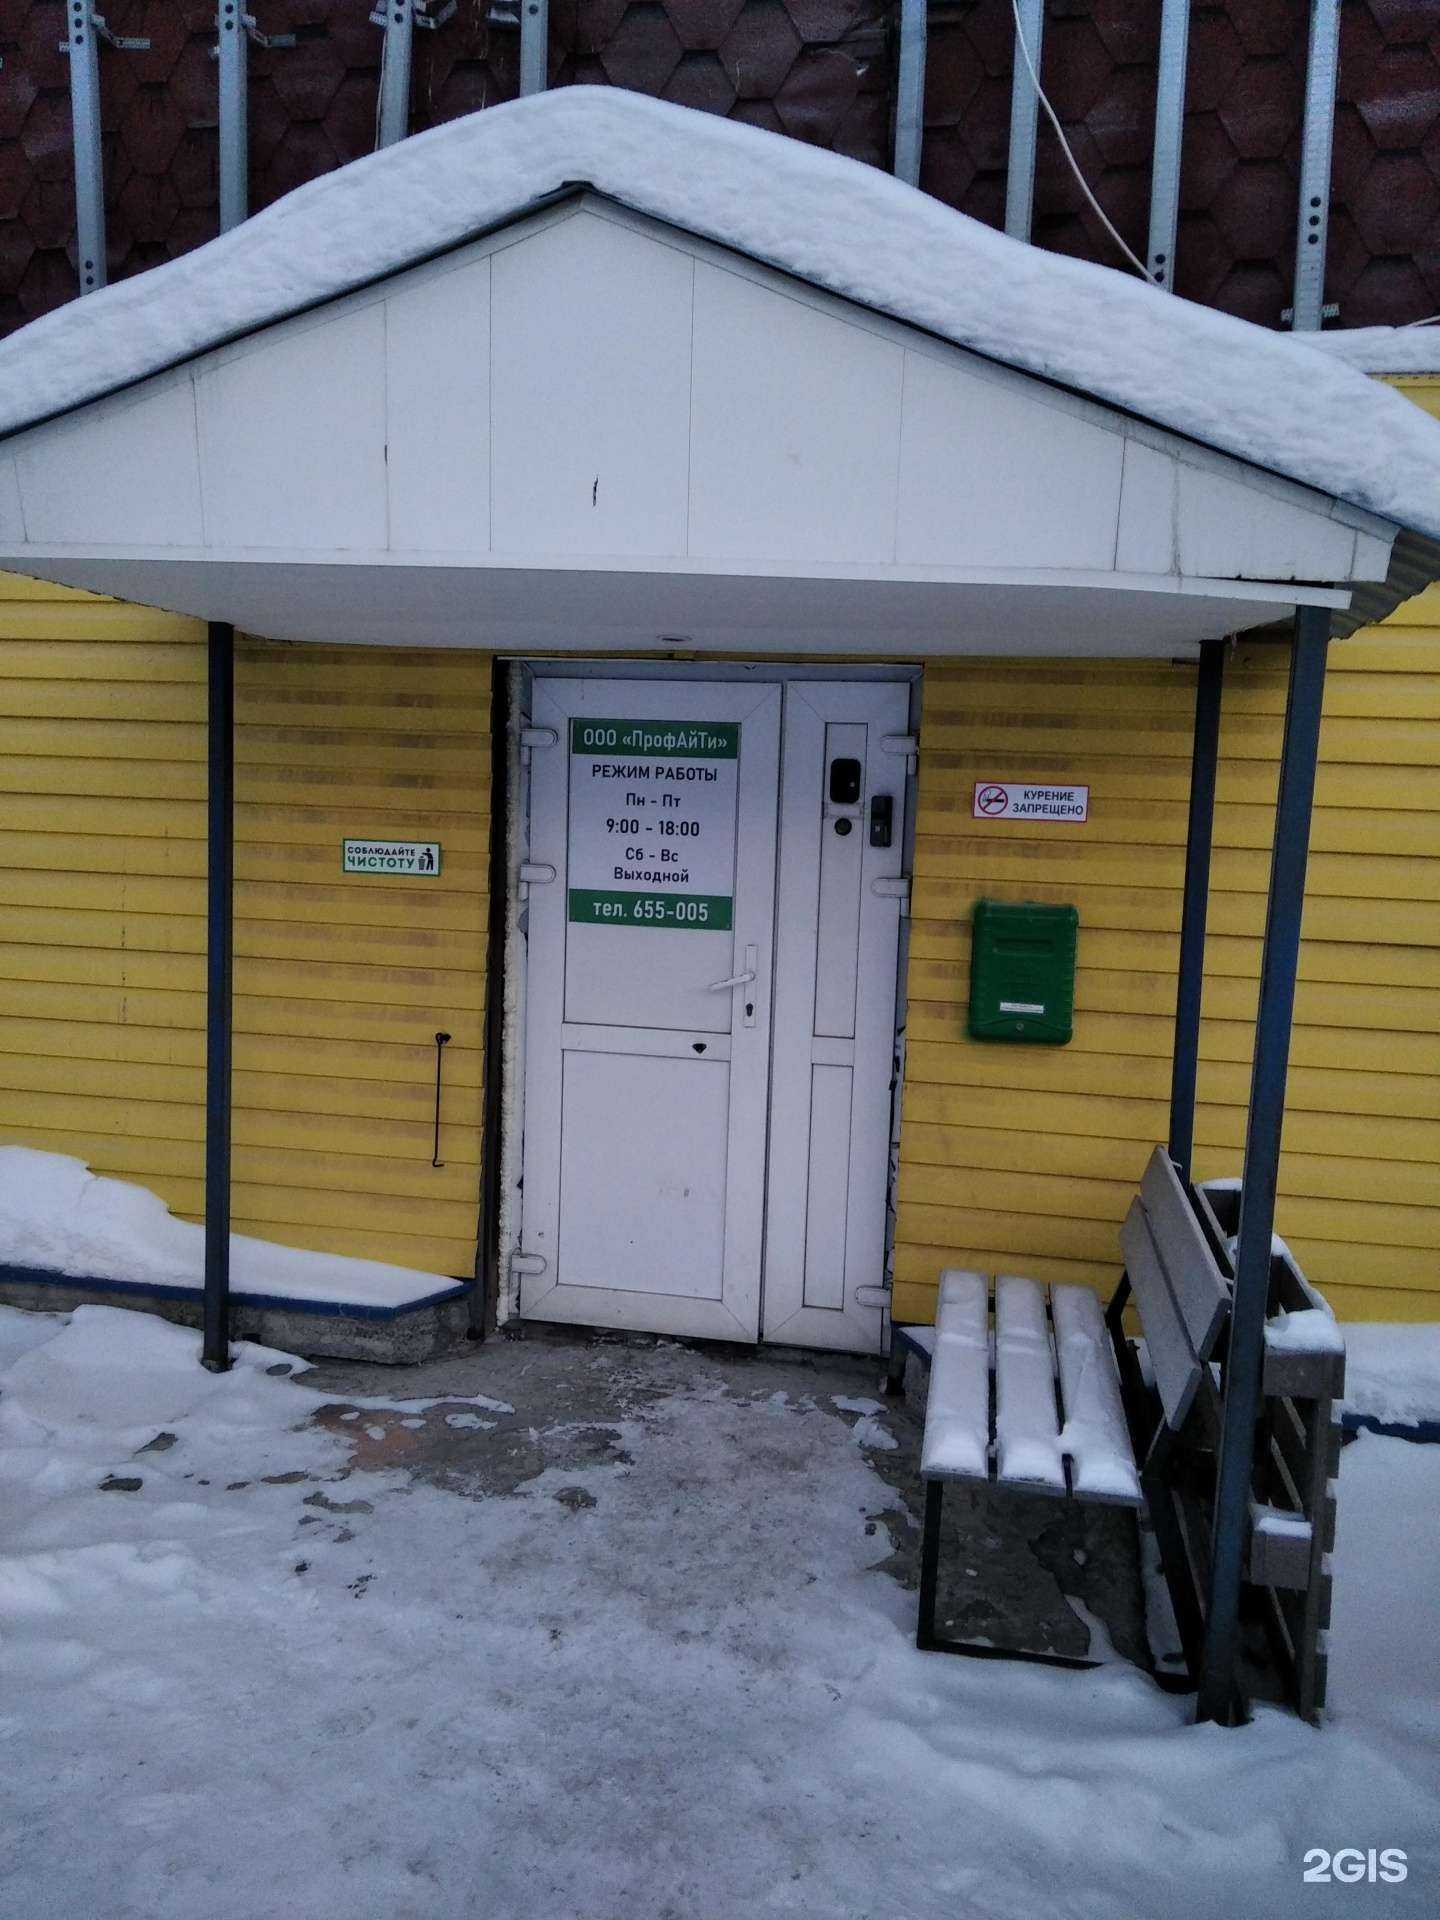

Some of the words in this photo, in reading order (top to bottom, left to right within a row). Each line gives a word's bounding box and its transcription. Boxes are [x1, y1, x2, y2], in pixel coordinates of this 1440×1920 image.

[583, 728, 617, 746] ООО
[622, 730, 728, 752] «ПрофАйТи»
[592, 764, 650, 779] РЕЖИМ
[655, 766, 717, 782] РАБОТЫ
[626, 793, 645, 807] Пн
[662, 794, 681, 808] Пт
[1023, 790, 1075, 802] КУРЕНИЕ
[1012, 803, 1084, 816] ЗАПРЕЩЕНО
[606, 818, 639, 834] 9:00
[659, 821, 700, 837] 18:00
[347, 846, 416, 857] СОБЛЮДАЙТЕ
[625, 847, 644, 861] Сб
[661, 849, 679, 862] Вс
[347, 855, 415, 869] ЧИСТОТУ
[614, 866, 689, 883] Выходной
[593, 901, 628, 918] тел.
[633, 899, 709, 921] 655-005
